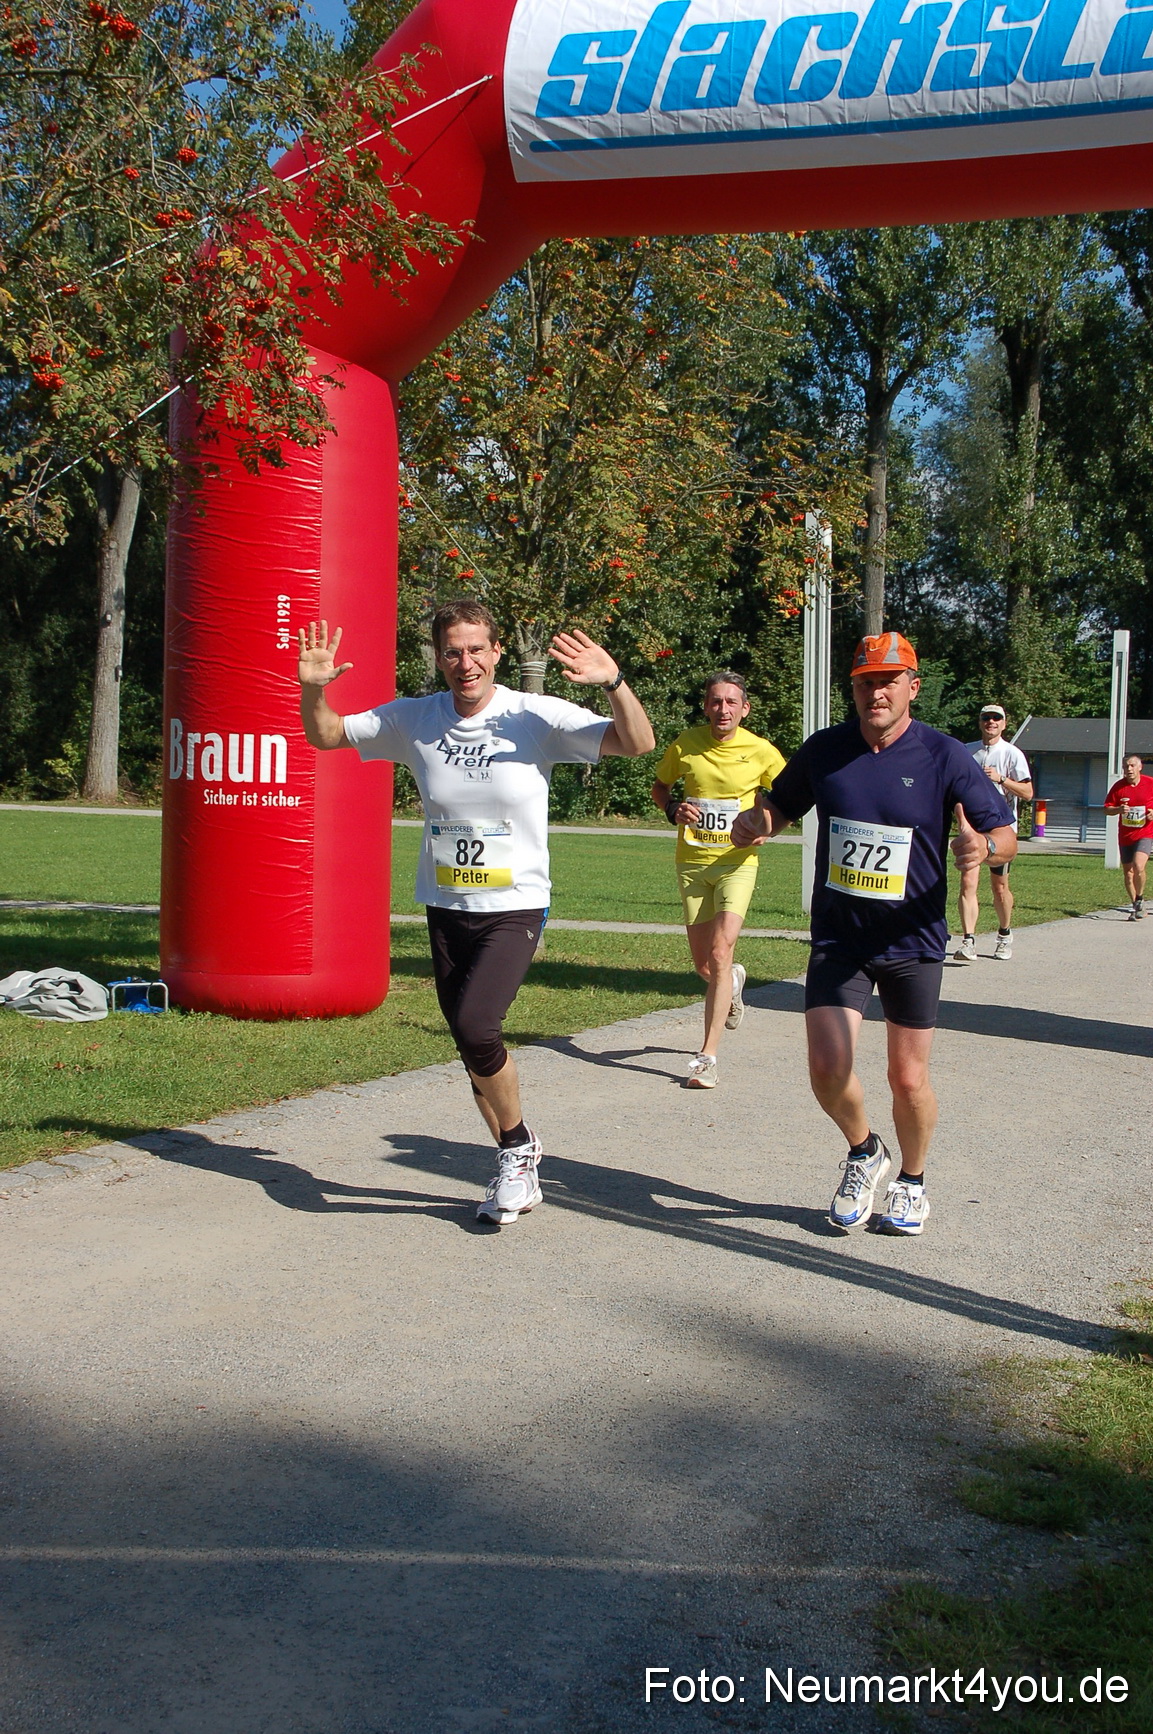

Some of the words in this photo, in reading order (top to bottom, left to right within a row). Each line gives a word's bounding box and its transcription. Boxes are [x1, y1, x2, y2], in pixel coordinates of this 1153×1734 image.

[277, 594, 291, 624] 1929
[276, 625, 290, 650] Seit
[169, 718, 288, 784] Braun
[436, 739, 488, 756] Lauf
[444, 751, 497, 768] Treff
[203, 788, 239, 806] Sicher
[242, 790, 258, 807] ist
[261, 789, 301, 808] sicher
[440, 825, 474, 834] PFLEIDERER
[696, 812, 727, 830] 905
[839, 824, 875, 837] PFLEIDERER
[693, 829, 730, 844] Juergen
[455, 838, 485, 866] 82
[841, 839, 892, 872] 272
[453, 868, 489, 884] Peter
[840, 867, 890, 890] Helmut
